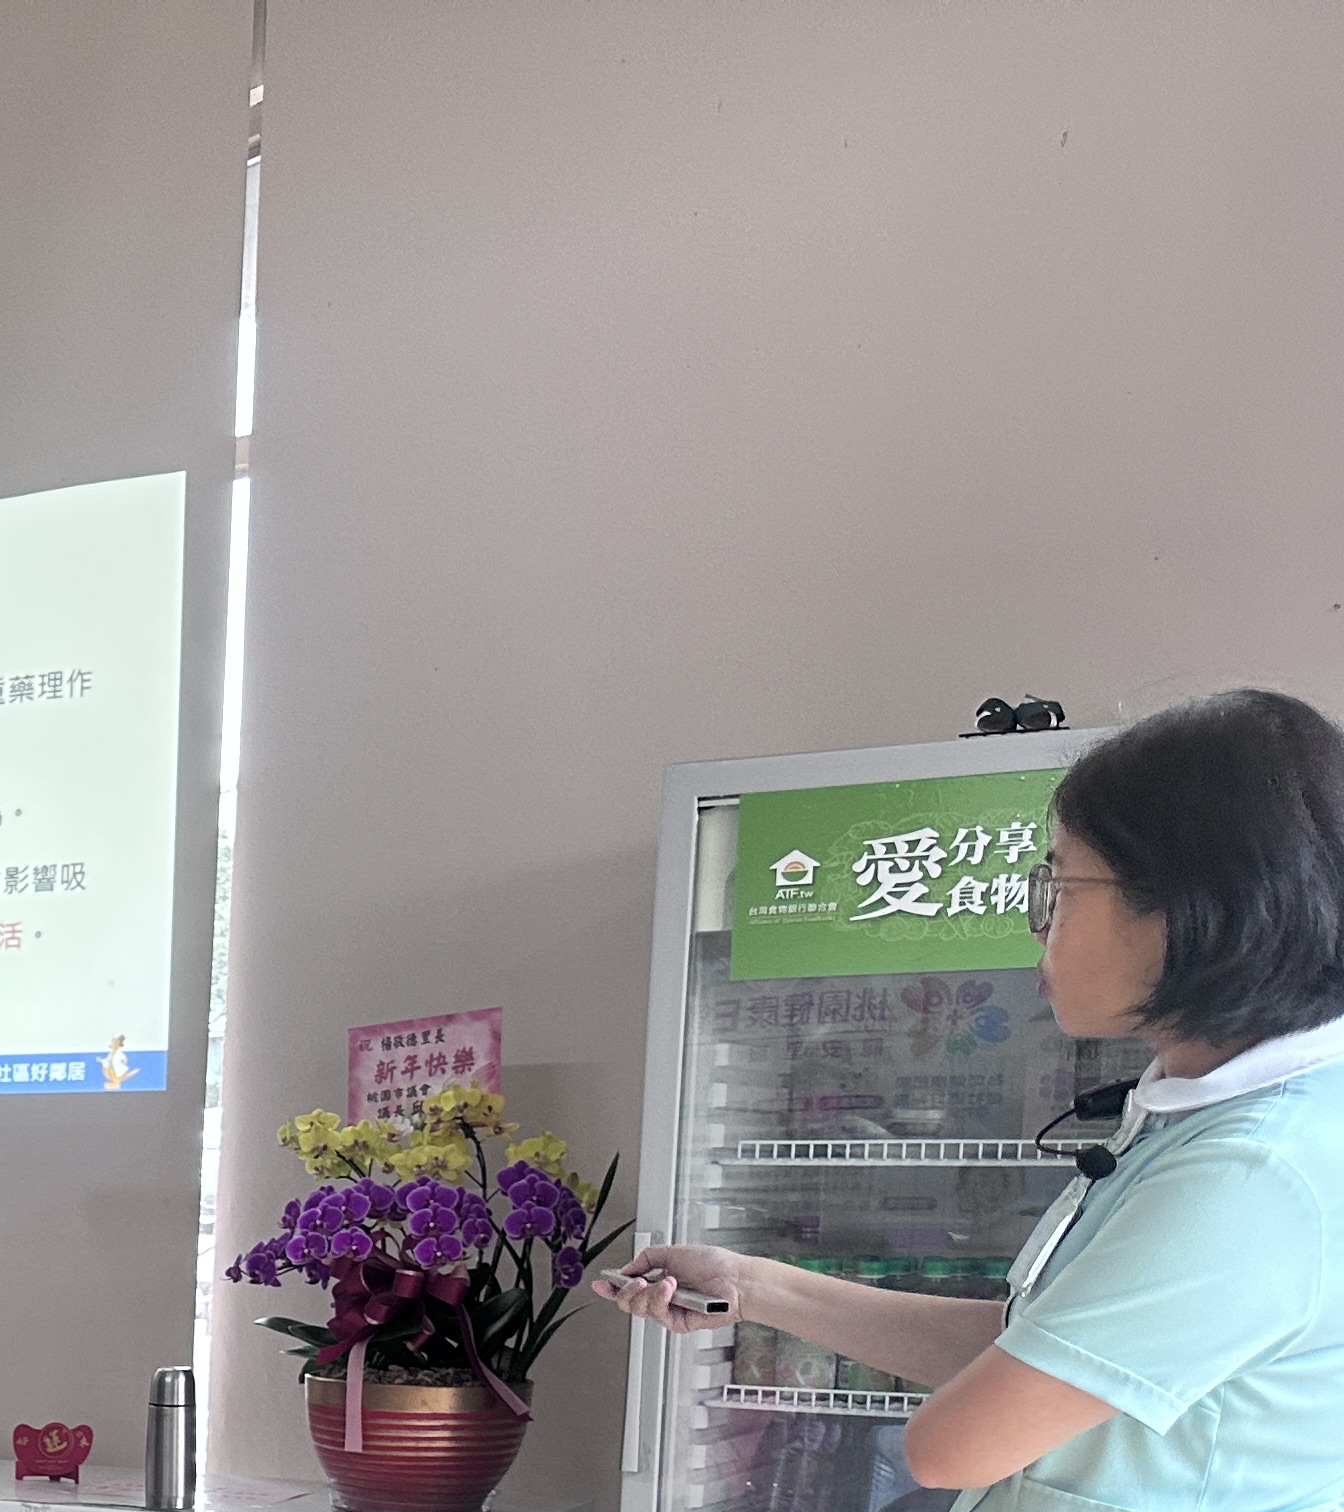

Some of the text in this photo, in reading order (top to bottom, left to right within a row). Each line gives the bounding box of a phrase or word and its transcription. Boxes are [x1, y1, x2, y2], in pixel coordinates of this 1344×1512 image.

[948, 821, 1039, 867] 分享
[849, 826, 948, 922] 愛
[945, 873, 1030, 918] 食物
[373, 1046, 476, 1085] 新年快樂
